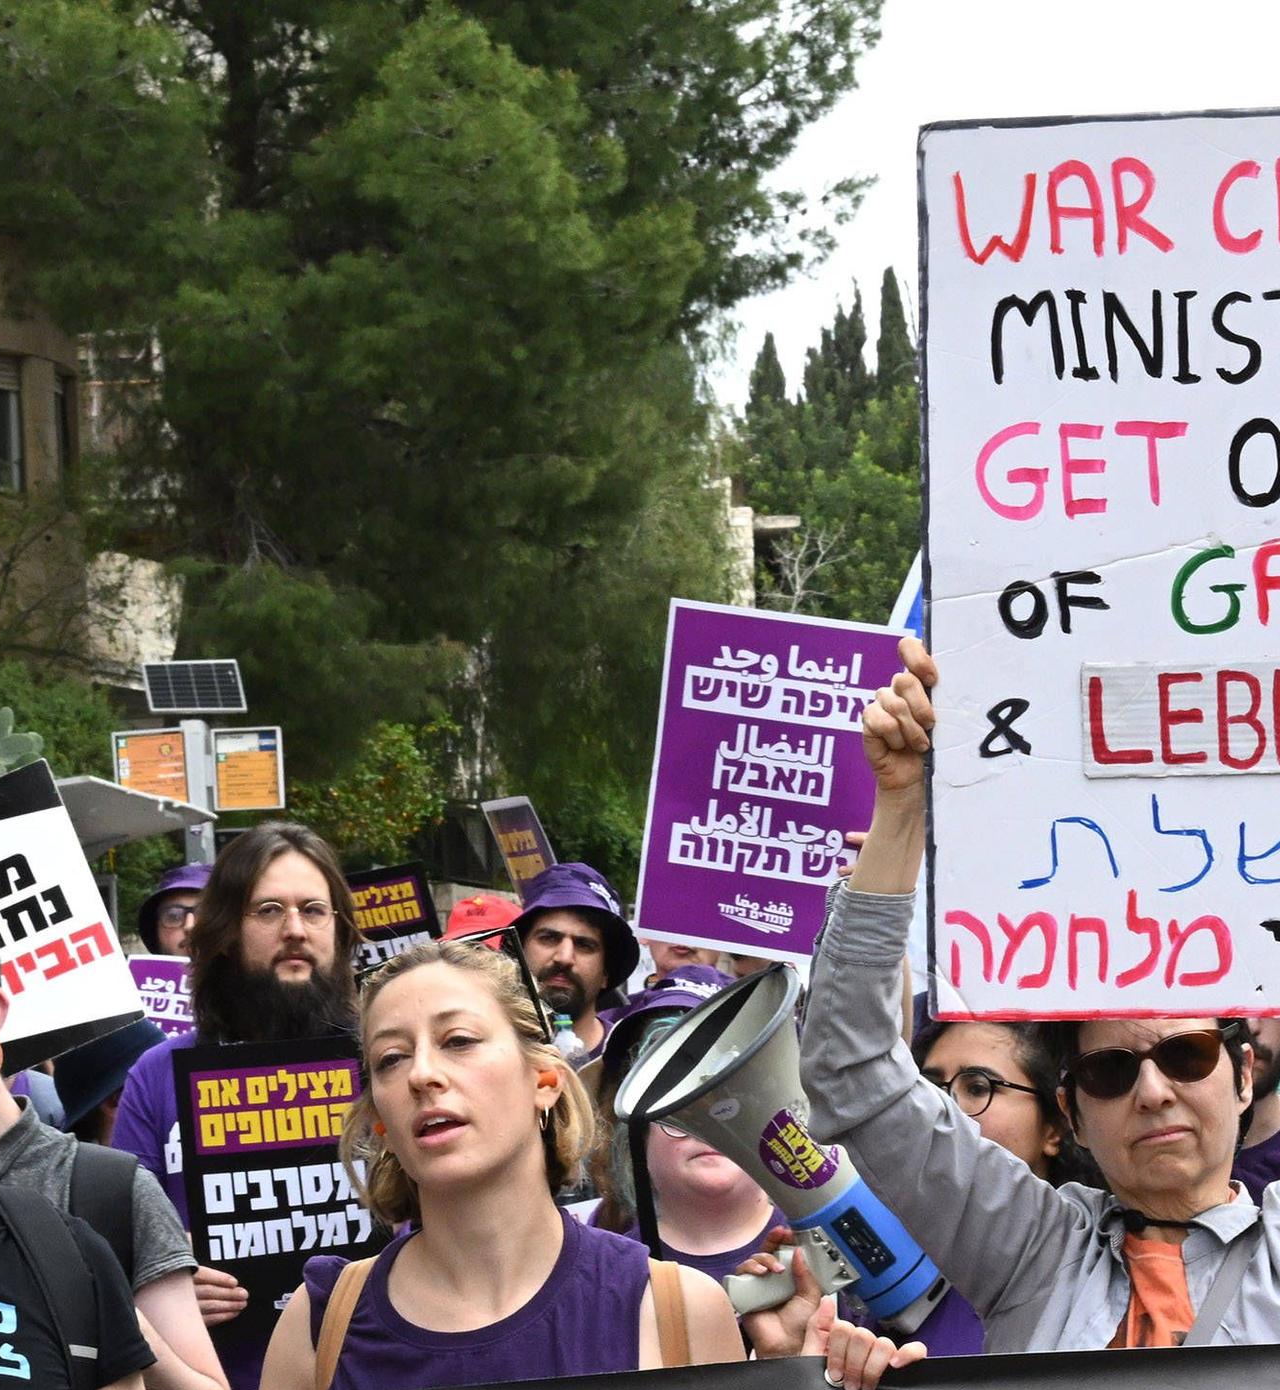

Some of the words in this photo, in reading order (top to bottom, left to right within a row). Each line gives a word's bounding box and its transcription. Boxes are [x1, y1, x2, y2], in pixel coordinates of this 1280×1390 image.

[953, 158, 1174, 265] WAR
[975, 421, 1189, 521] GET
[998, 571, 1110, 638] OF
[713, 644, 779, 684] وجد
[692, 675, 771, 709] שיש
[719, 723, 836, 767] النضال
[979, 699, 1032, 758] &
[719, 758, 825, 798] מאבק
[679, 831, 791, 875] תקווה
[777, 819, 844, 857] وجد
[802, 846, 848, 879] יש
[945, 890, 1233, 992] מלחמה
[197, 1077, 240, 1108] את
[246, 1069, 353, 1104] מצילים
[203, 1160, 369, 1213] מסרבים
[208, 1204, 371, 1261] למלחמה
